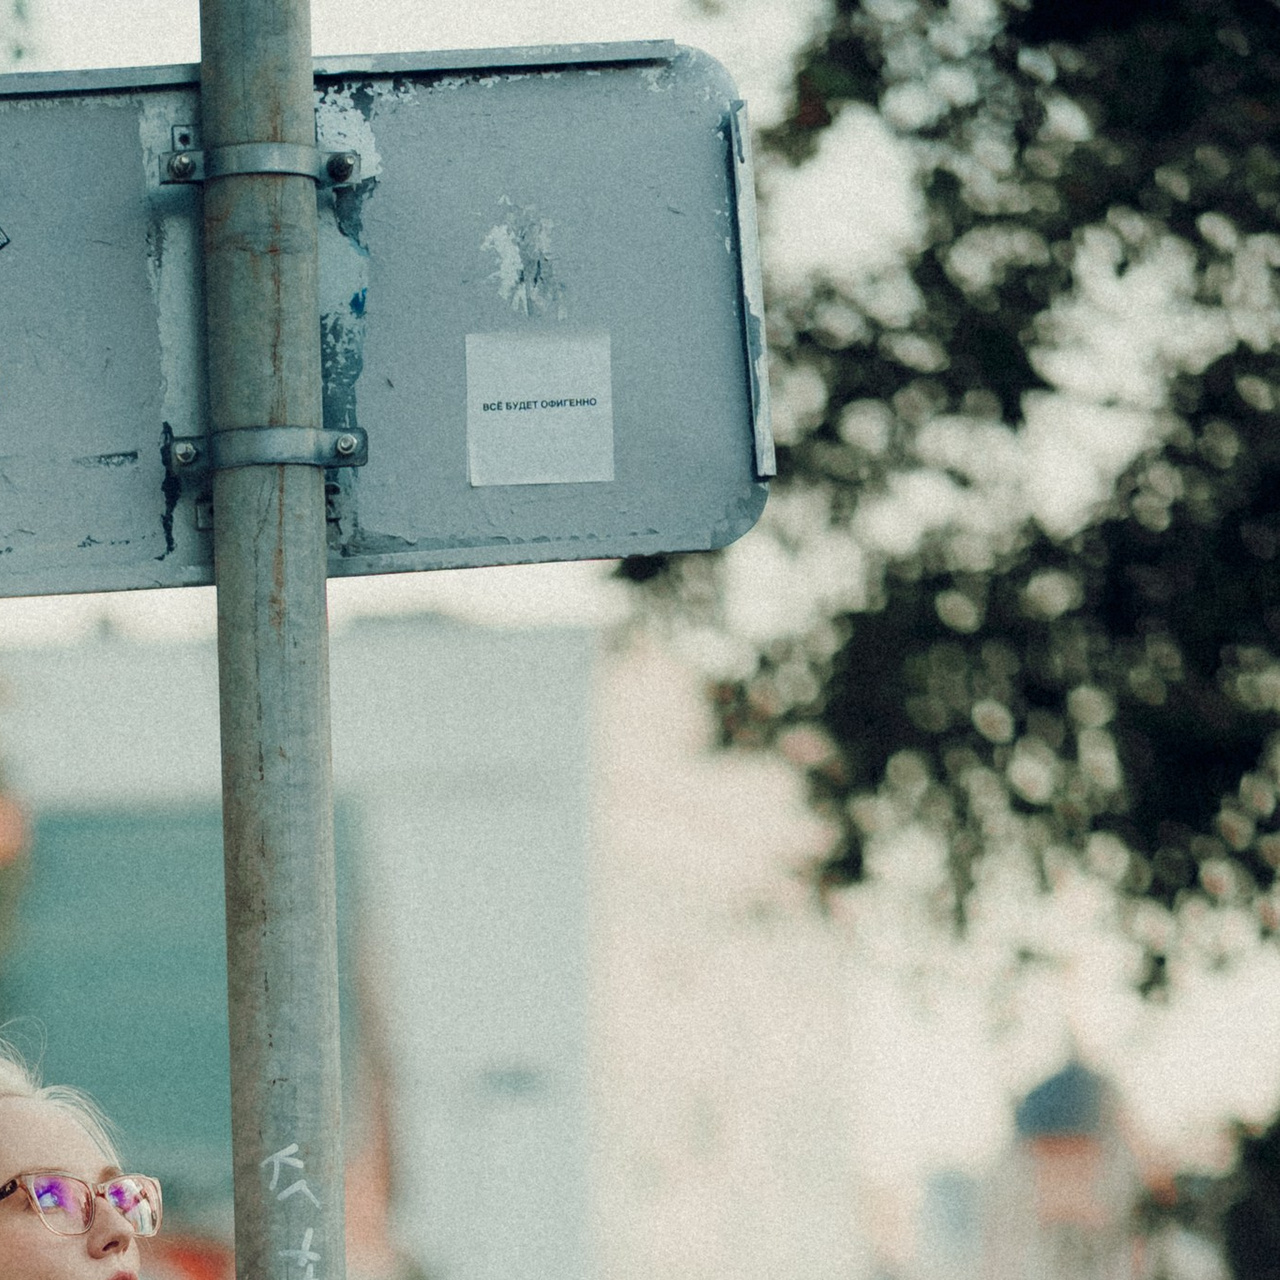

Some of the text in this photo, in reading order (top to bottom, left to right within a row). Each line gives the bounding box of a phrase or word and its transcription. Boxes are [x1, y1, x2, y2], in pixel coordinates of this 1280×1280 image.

[482, 397, 597, 411] ВСЁ БУДЕТ ОФИГЕННО
